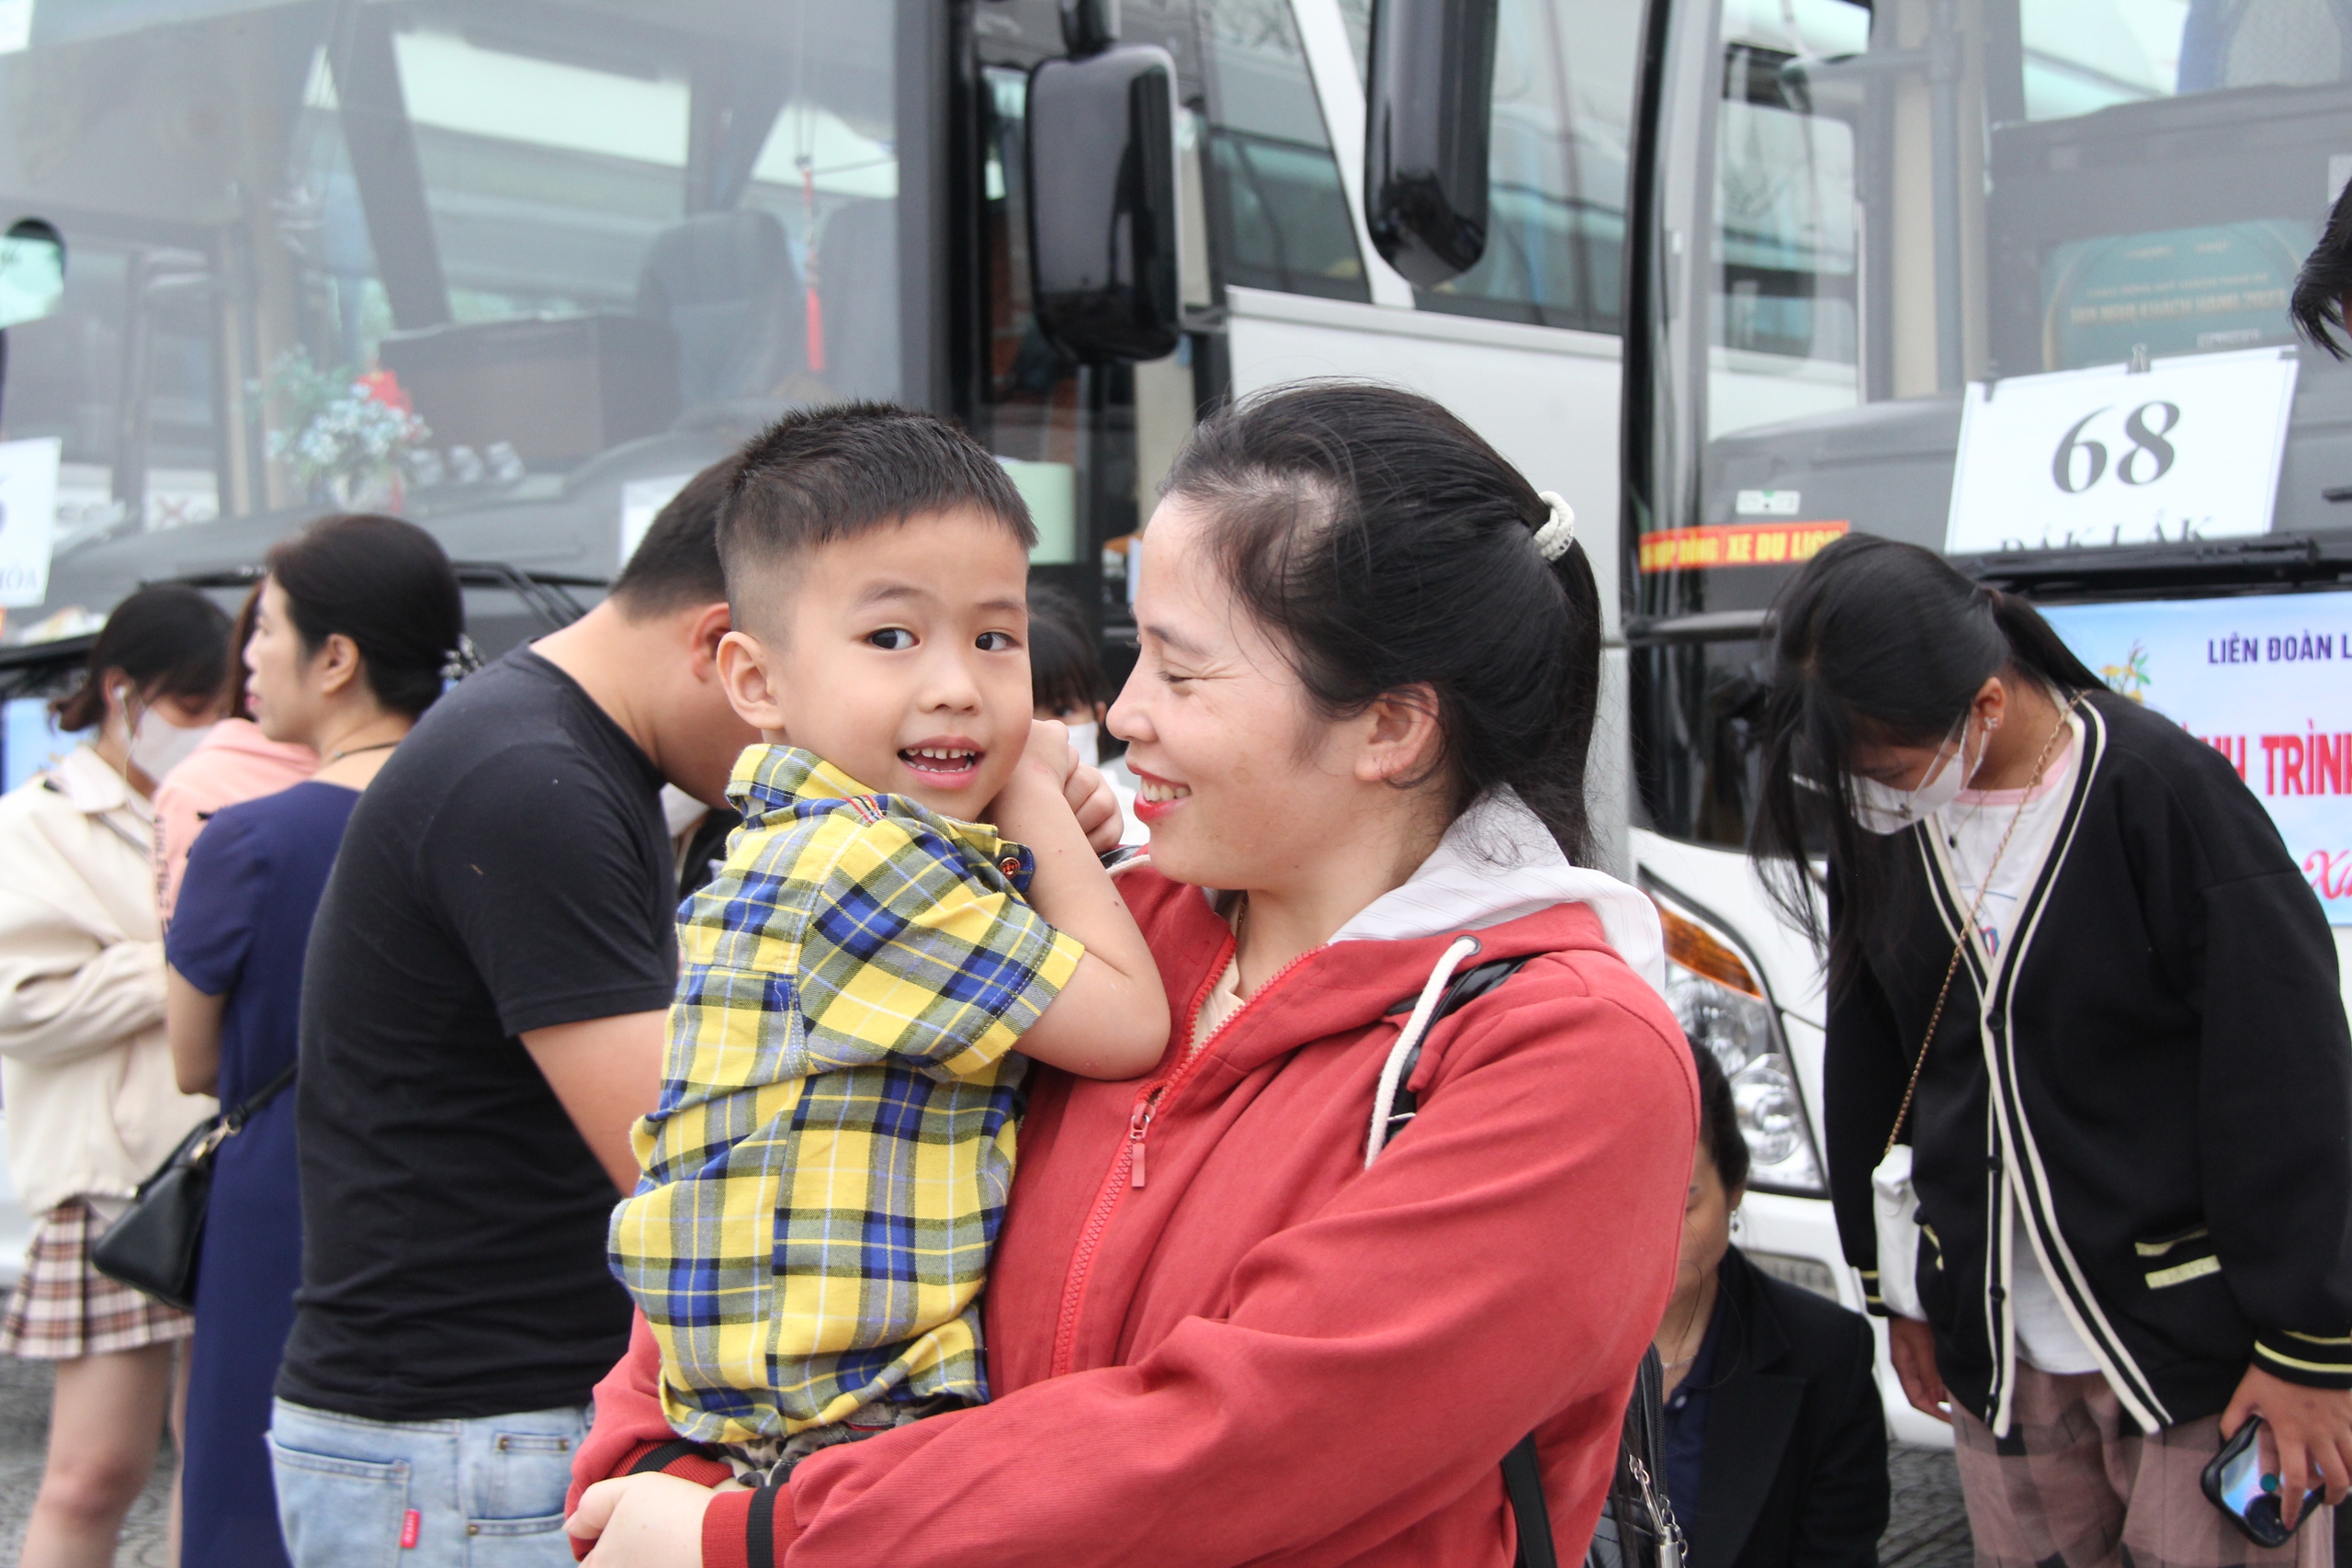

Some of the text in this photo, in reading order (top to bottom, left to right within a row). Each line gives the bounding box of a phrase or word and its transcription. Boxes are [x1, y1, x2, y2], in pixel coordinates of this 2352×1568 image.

[2050, 400, 2181, 494] 68
[2207, 631, 2259, 664] LIÊN
[2266, 628, 2333, 661] ĐOÀN
